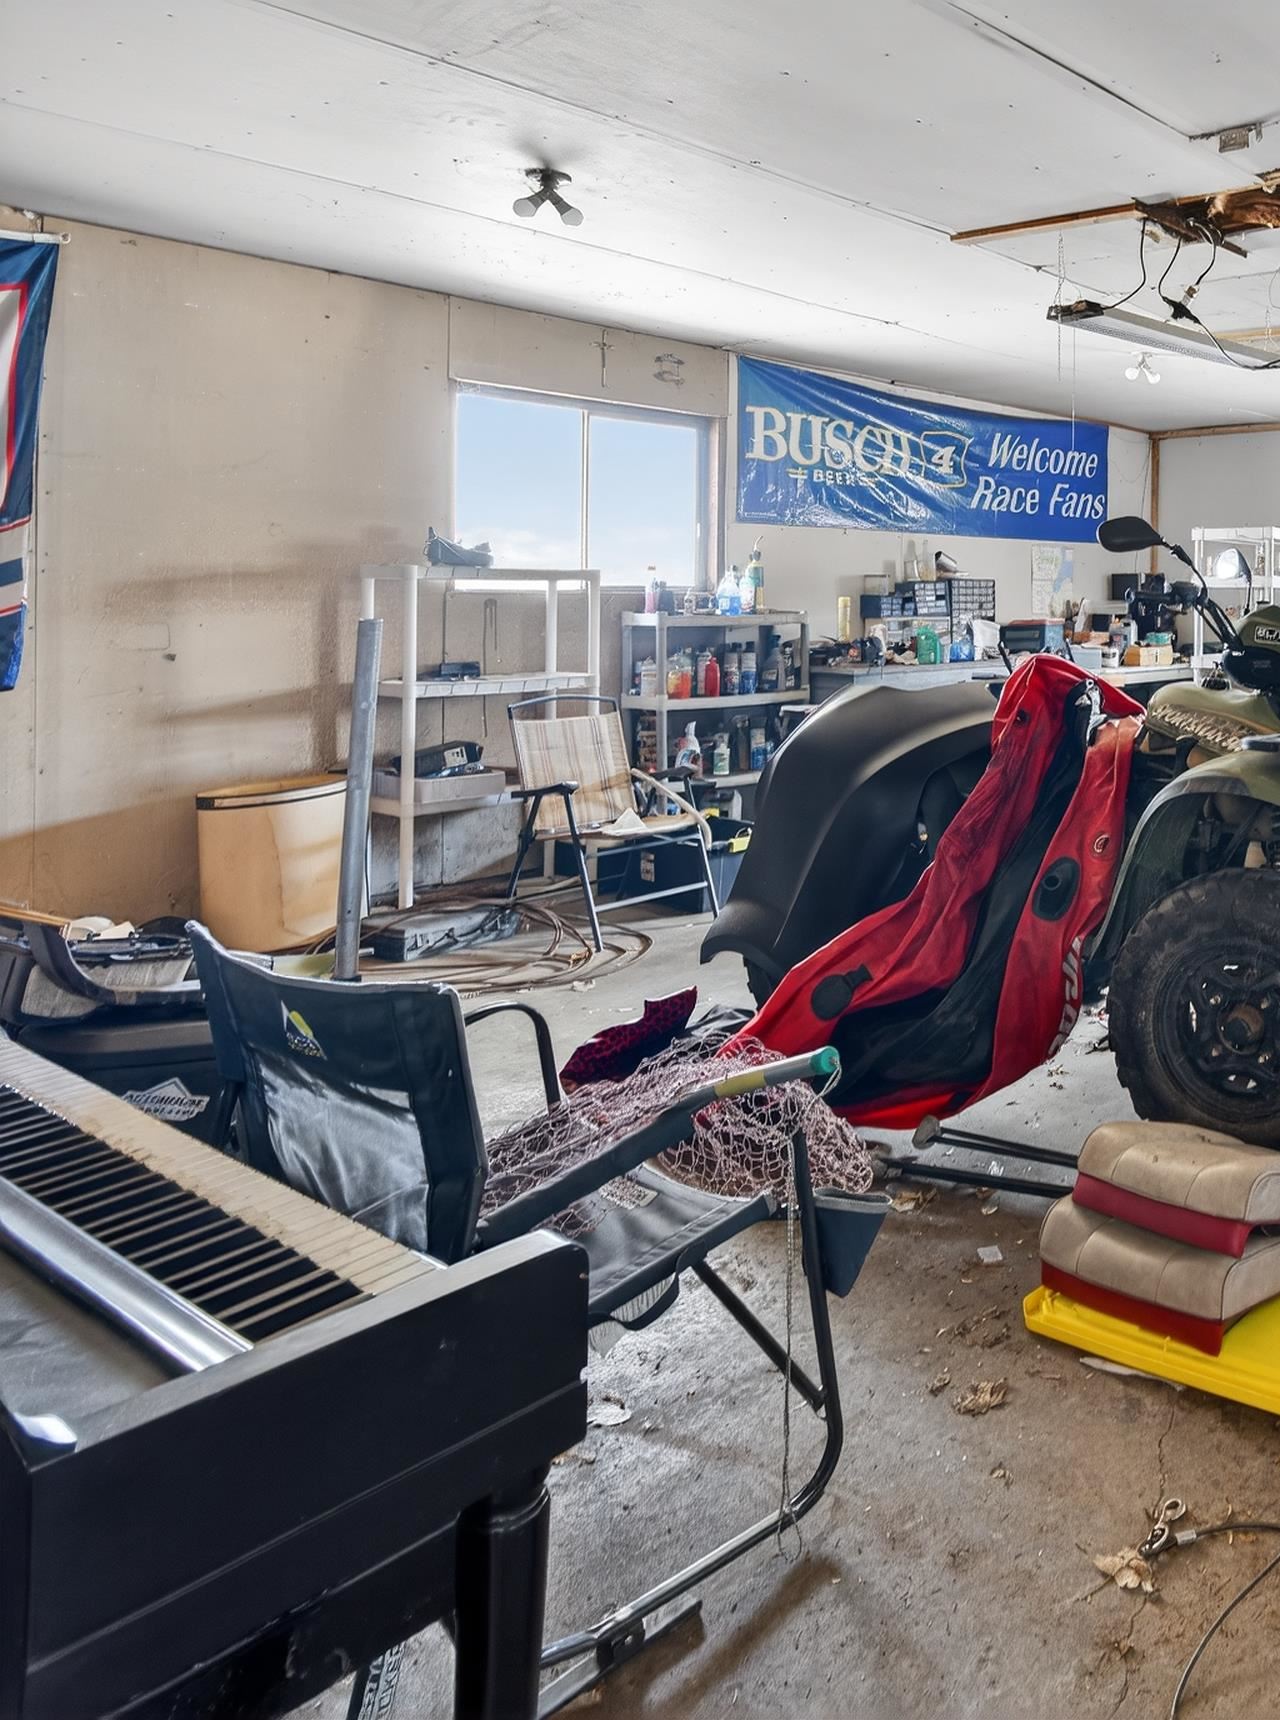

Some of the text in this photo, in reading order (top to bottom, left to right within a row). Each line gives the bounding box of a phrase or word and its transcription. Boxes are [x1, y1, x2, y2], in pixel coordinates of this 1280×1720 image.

[745, 405, 911, 476] BUSCH
[931, 446, 956, 474] 4
[987, 431, 1099, 479] Welcome
[970, 475, 1106, 520] Race Fans
